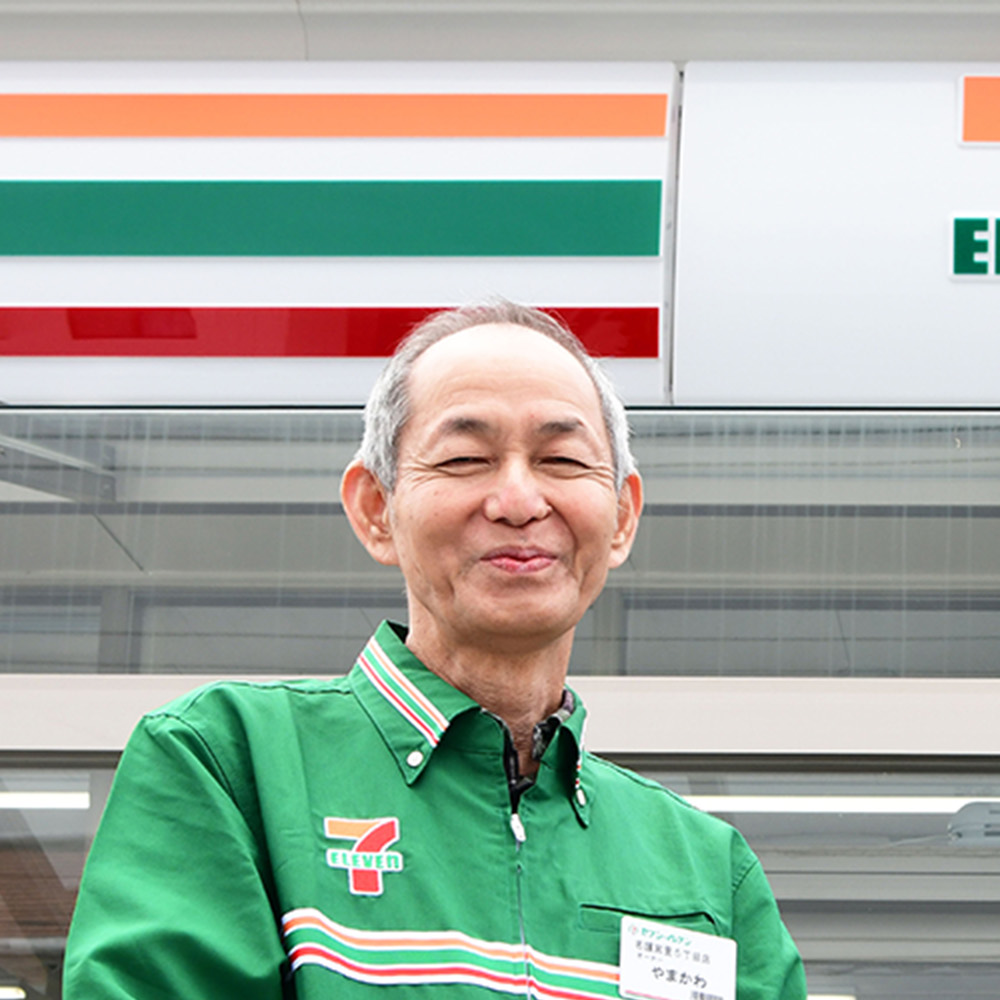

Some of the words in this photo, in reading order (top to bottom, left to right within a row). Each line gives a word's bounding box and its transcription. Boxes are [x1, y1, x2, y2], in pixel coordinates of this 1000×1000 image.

[327, 819, 396, 893] 7
[651, 966, 708, 989] やまかわ
